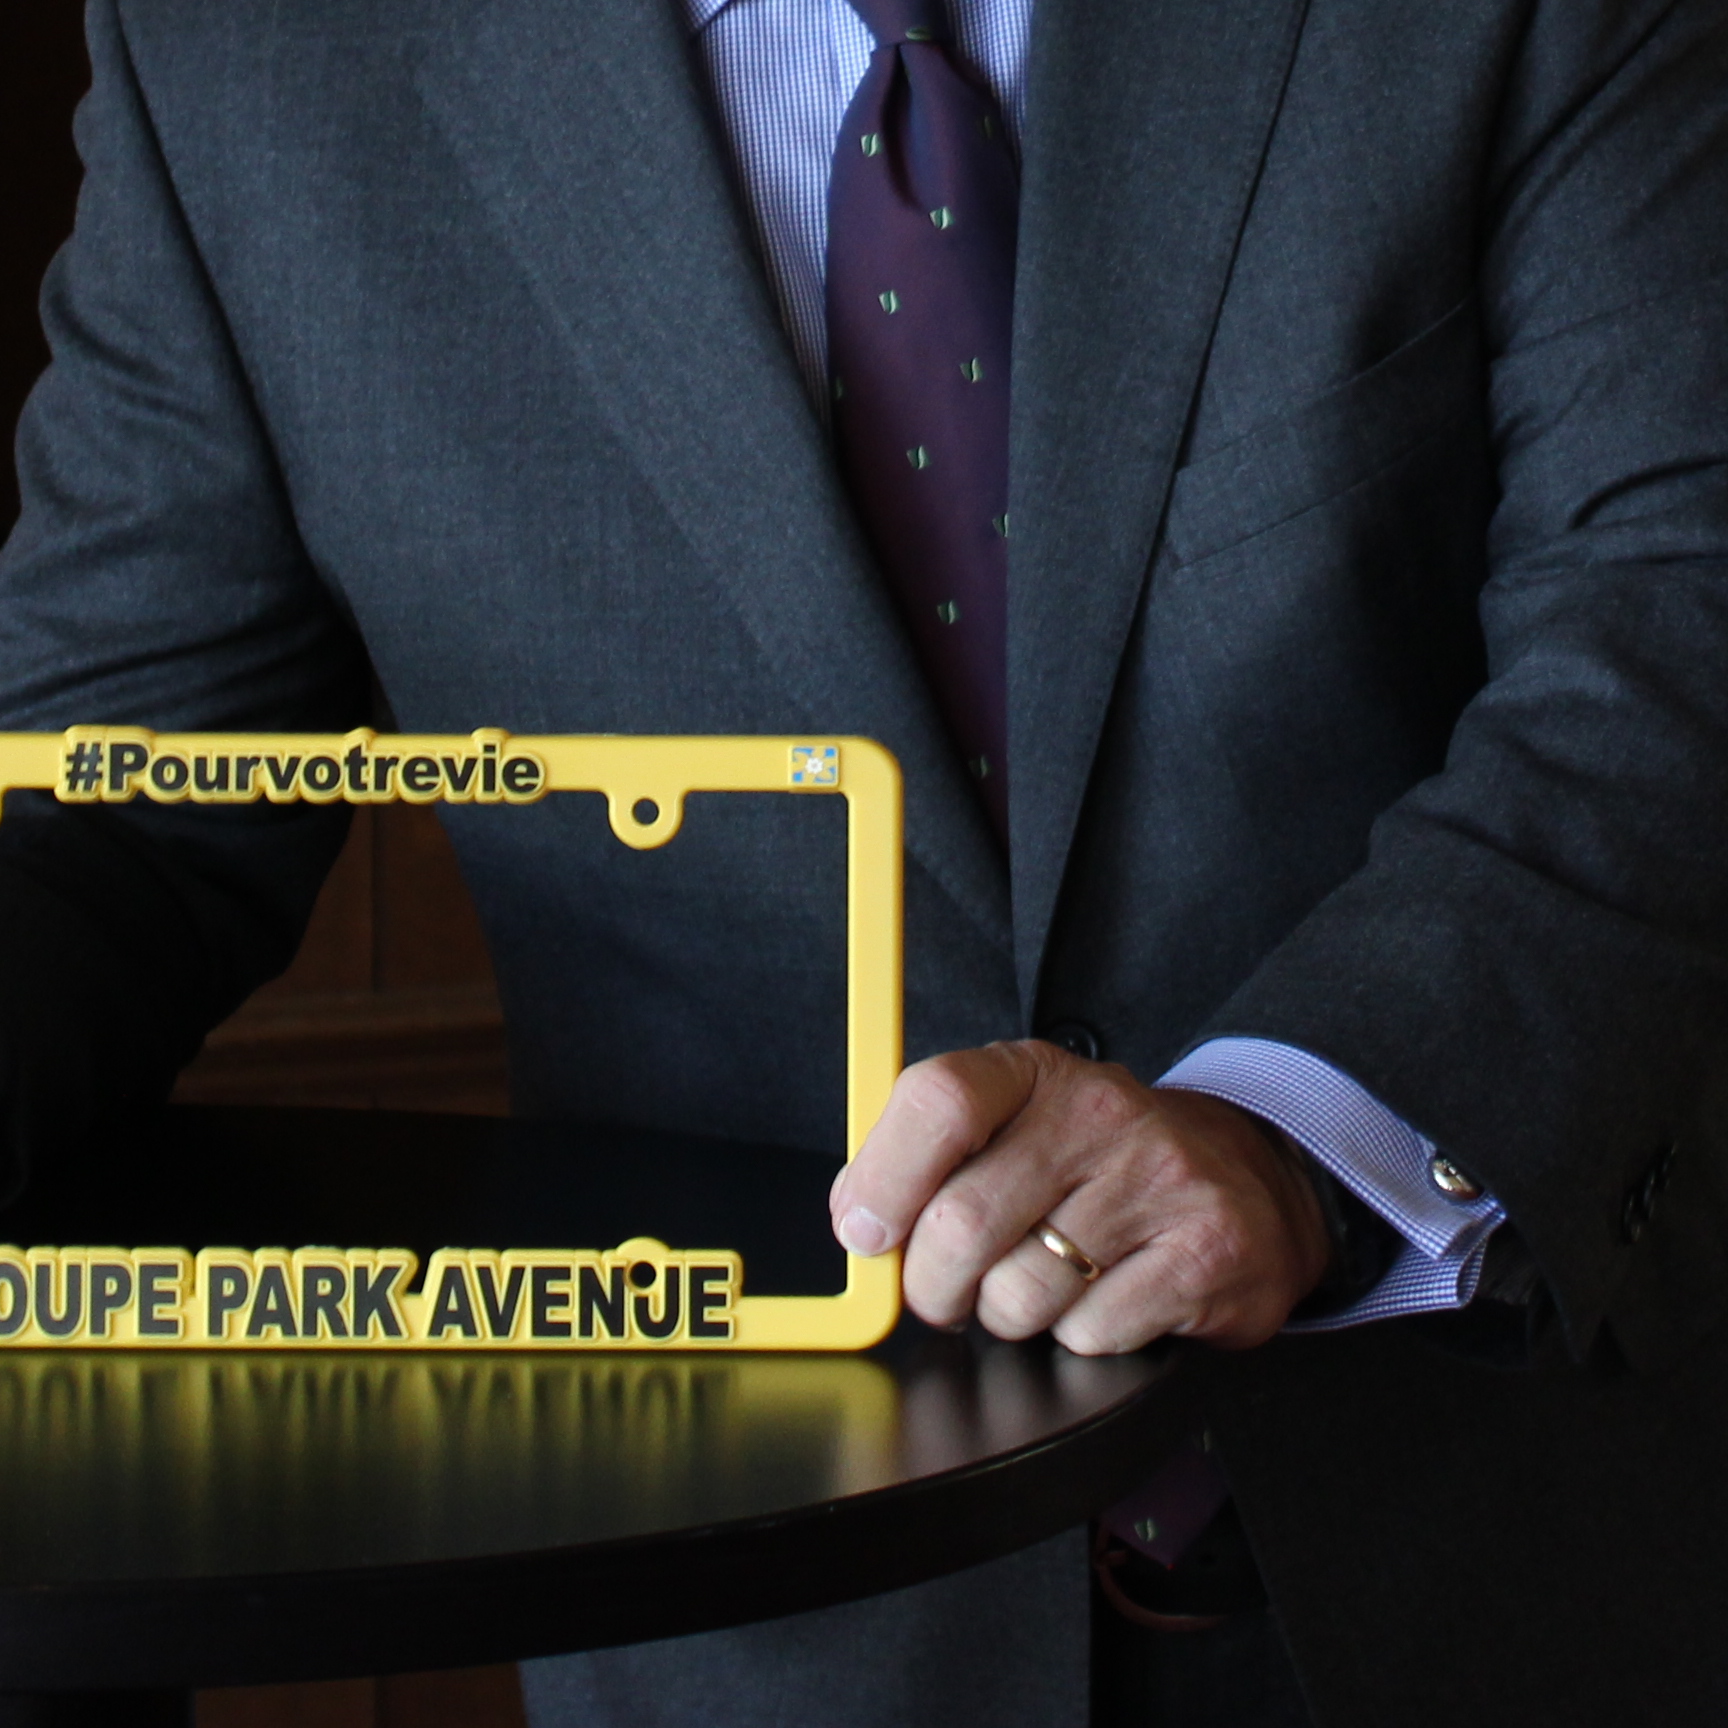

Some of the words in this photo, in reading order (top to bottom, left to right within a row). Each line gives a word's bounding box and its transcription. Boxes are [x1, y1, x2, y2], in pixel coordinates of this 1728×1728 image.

[65, 742, 541, 793] #Pourvotrevie
[207, 1264, 404, 1337] PARK
[427, 1265, 734, 1339] AVENUE
